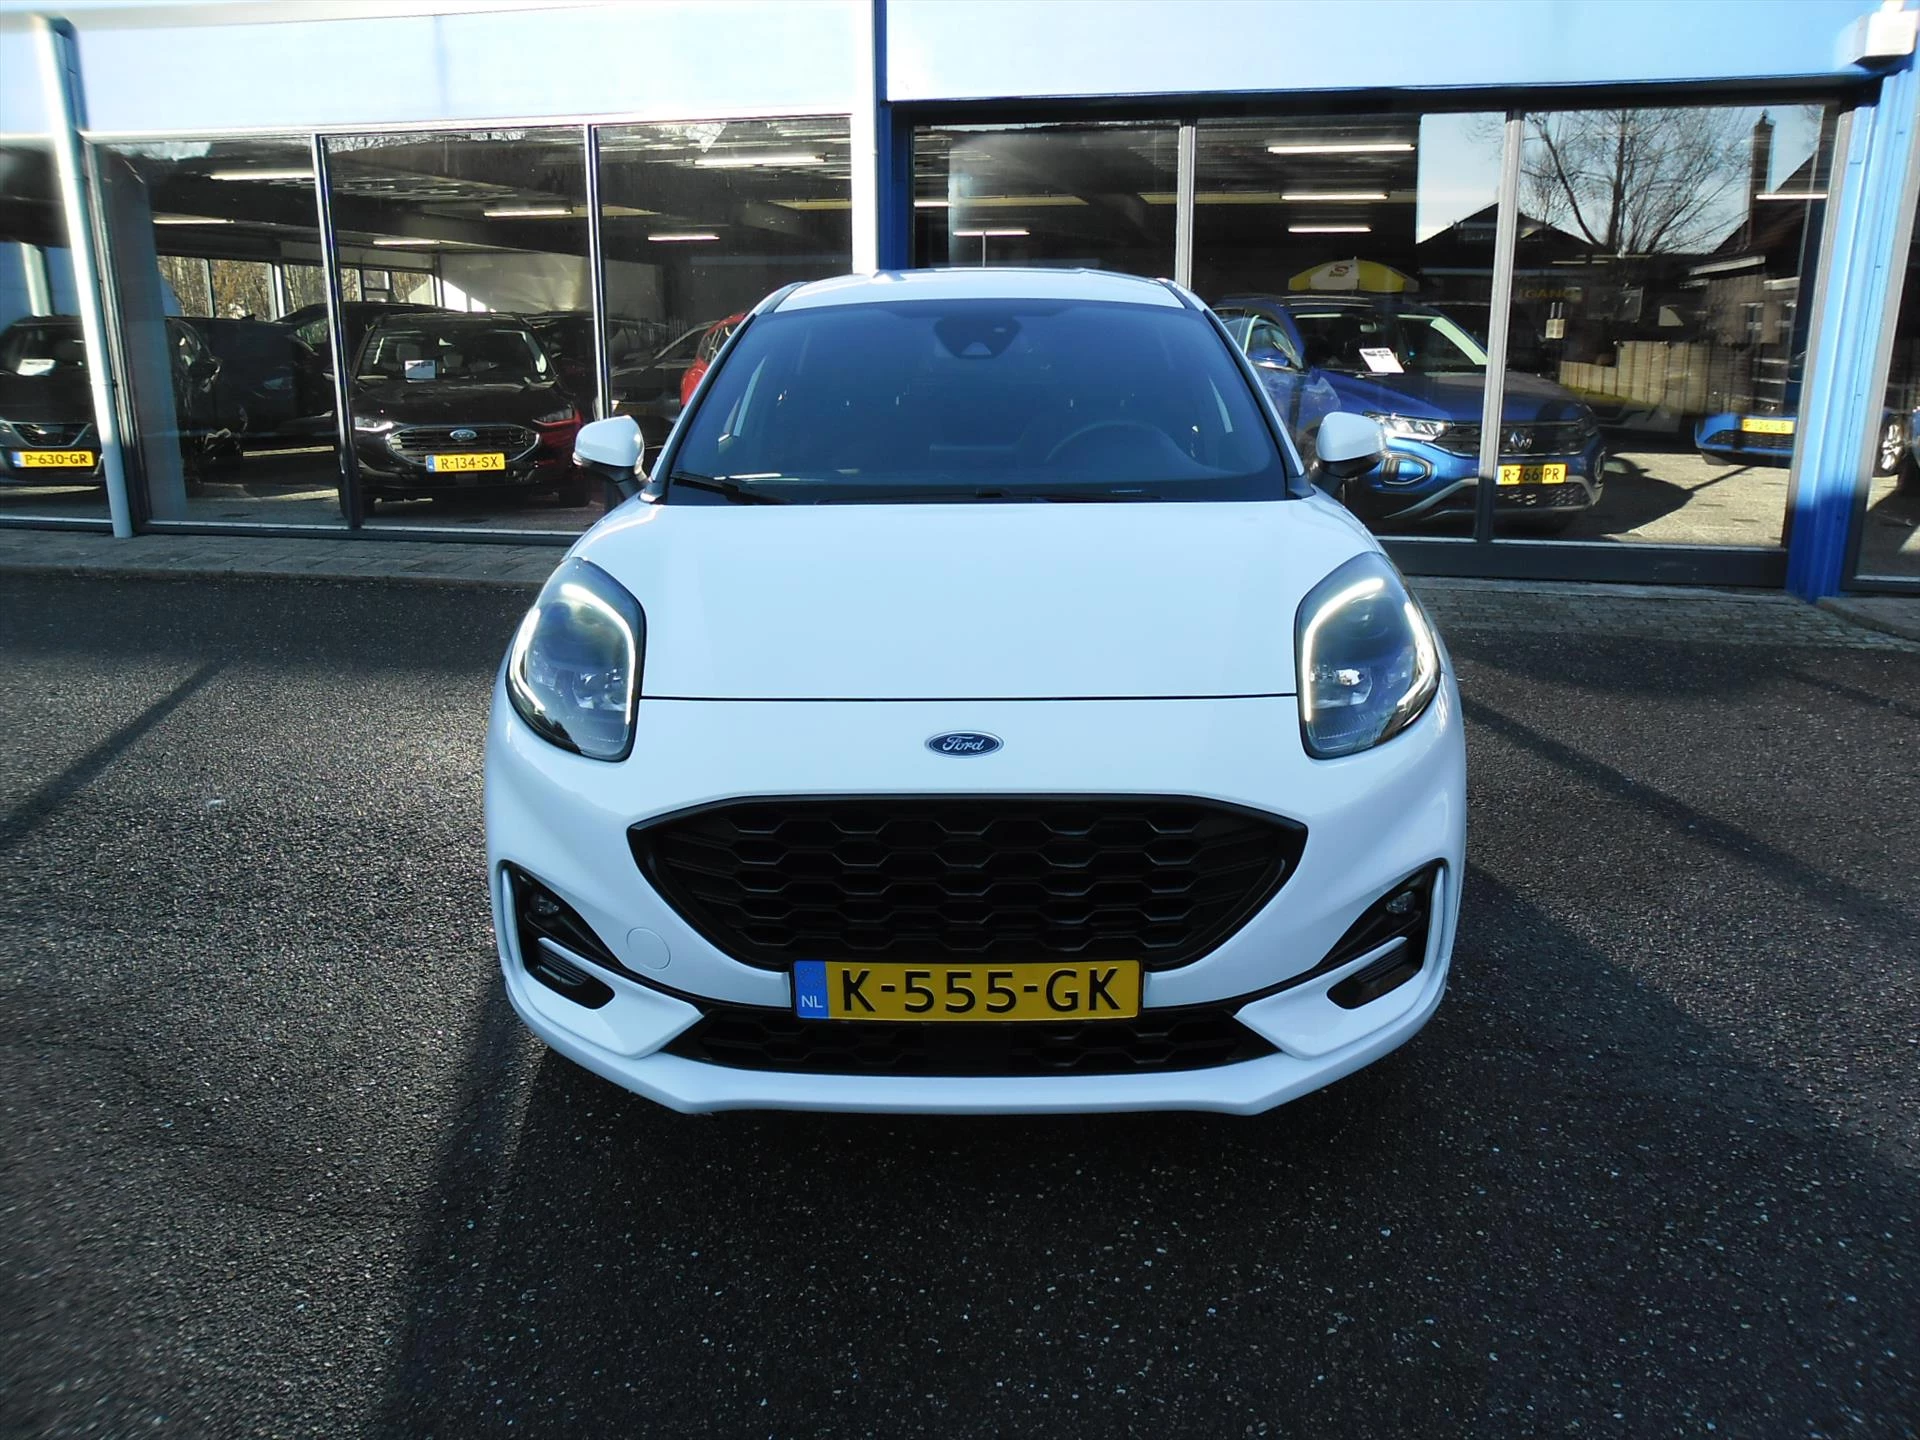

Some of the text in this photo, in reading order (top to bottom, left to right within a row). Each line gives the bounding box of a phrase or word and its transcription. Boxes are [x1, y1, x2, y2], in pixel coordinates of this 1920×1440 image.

[24, 453, 88, 465] P-630-GR
[440, 456, 498, 469] R-134-SX
[1503, 467, 1560, 482] R-766-PR
[942, 735, 985, 751] Ford
[841, 967, 1121, 1013] K-555-GK
[801, 995, 824, 1008] NL
